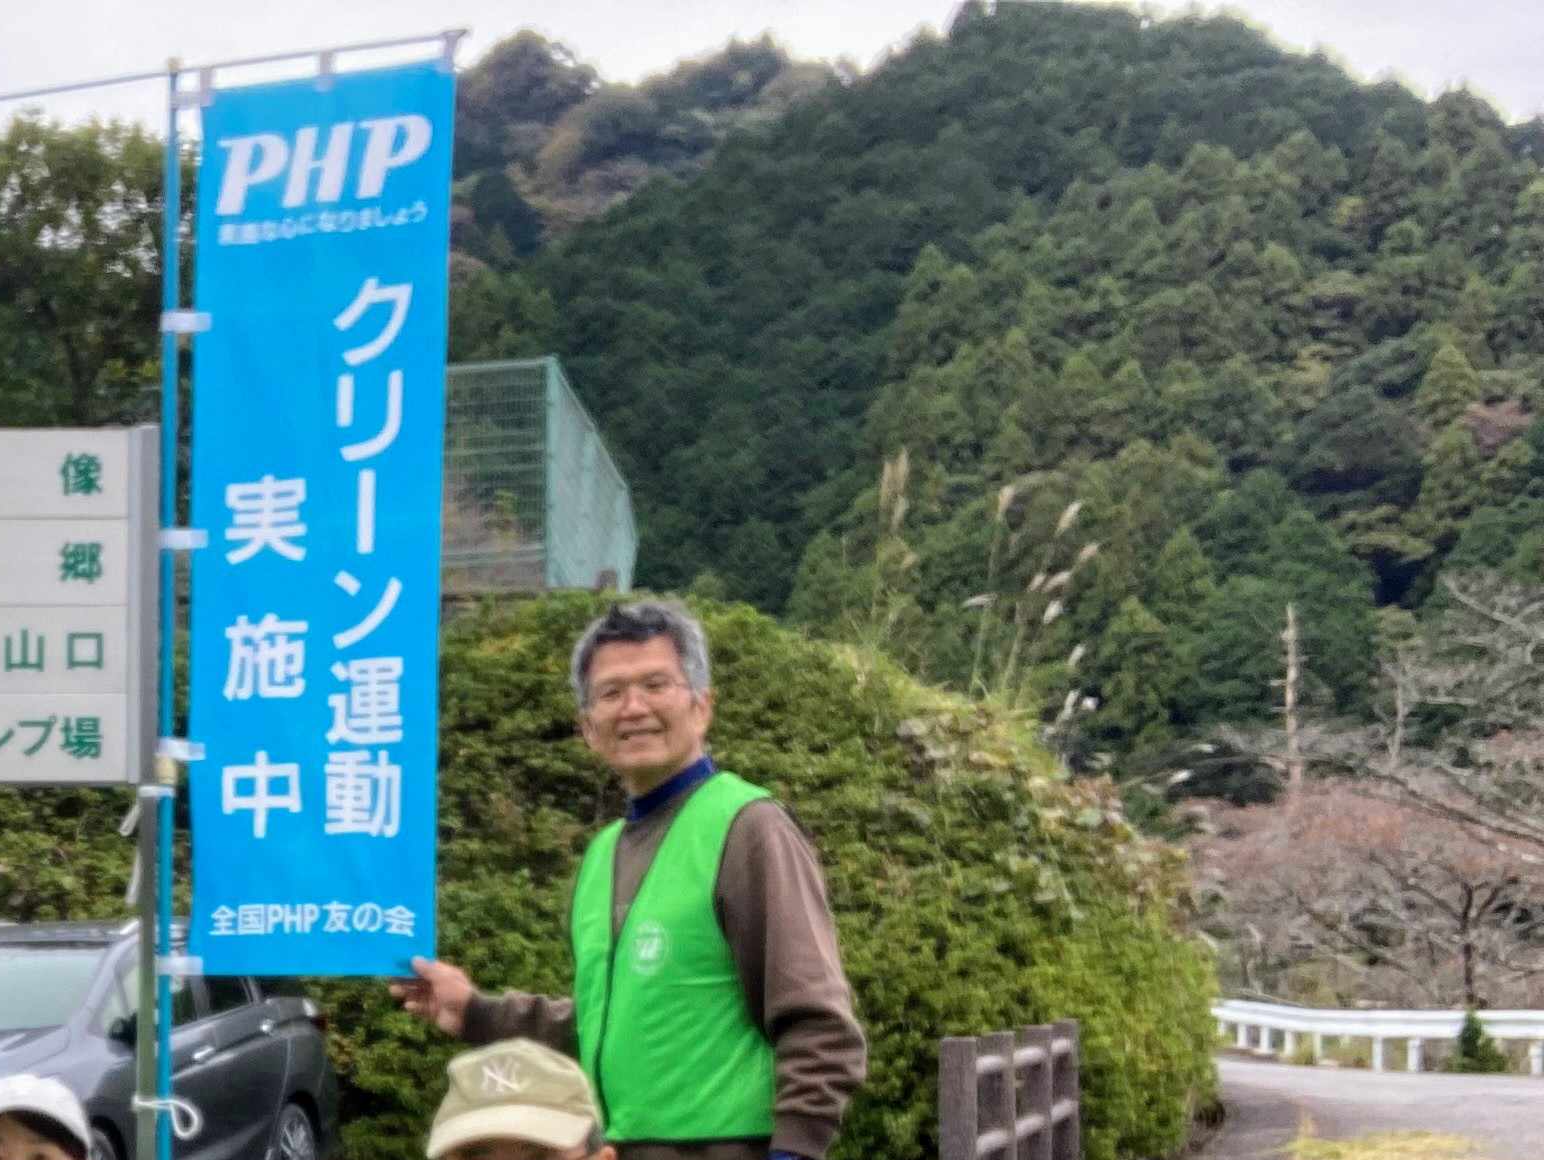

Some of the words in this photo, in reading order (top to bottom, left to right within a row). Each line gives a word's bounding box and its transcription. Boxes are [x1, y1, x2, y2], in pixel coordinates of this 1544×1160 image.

[215, 114, 433, 216] PHP
[222, 474, 309, 839] 実施中
[324, 277, 415, 839] クリーン運動
[209, 901, 416, 937] 全国PHP友の会
